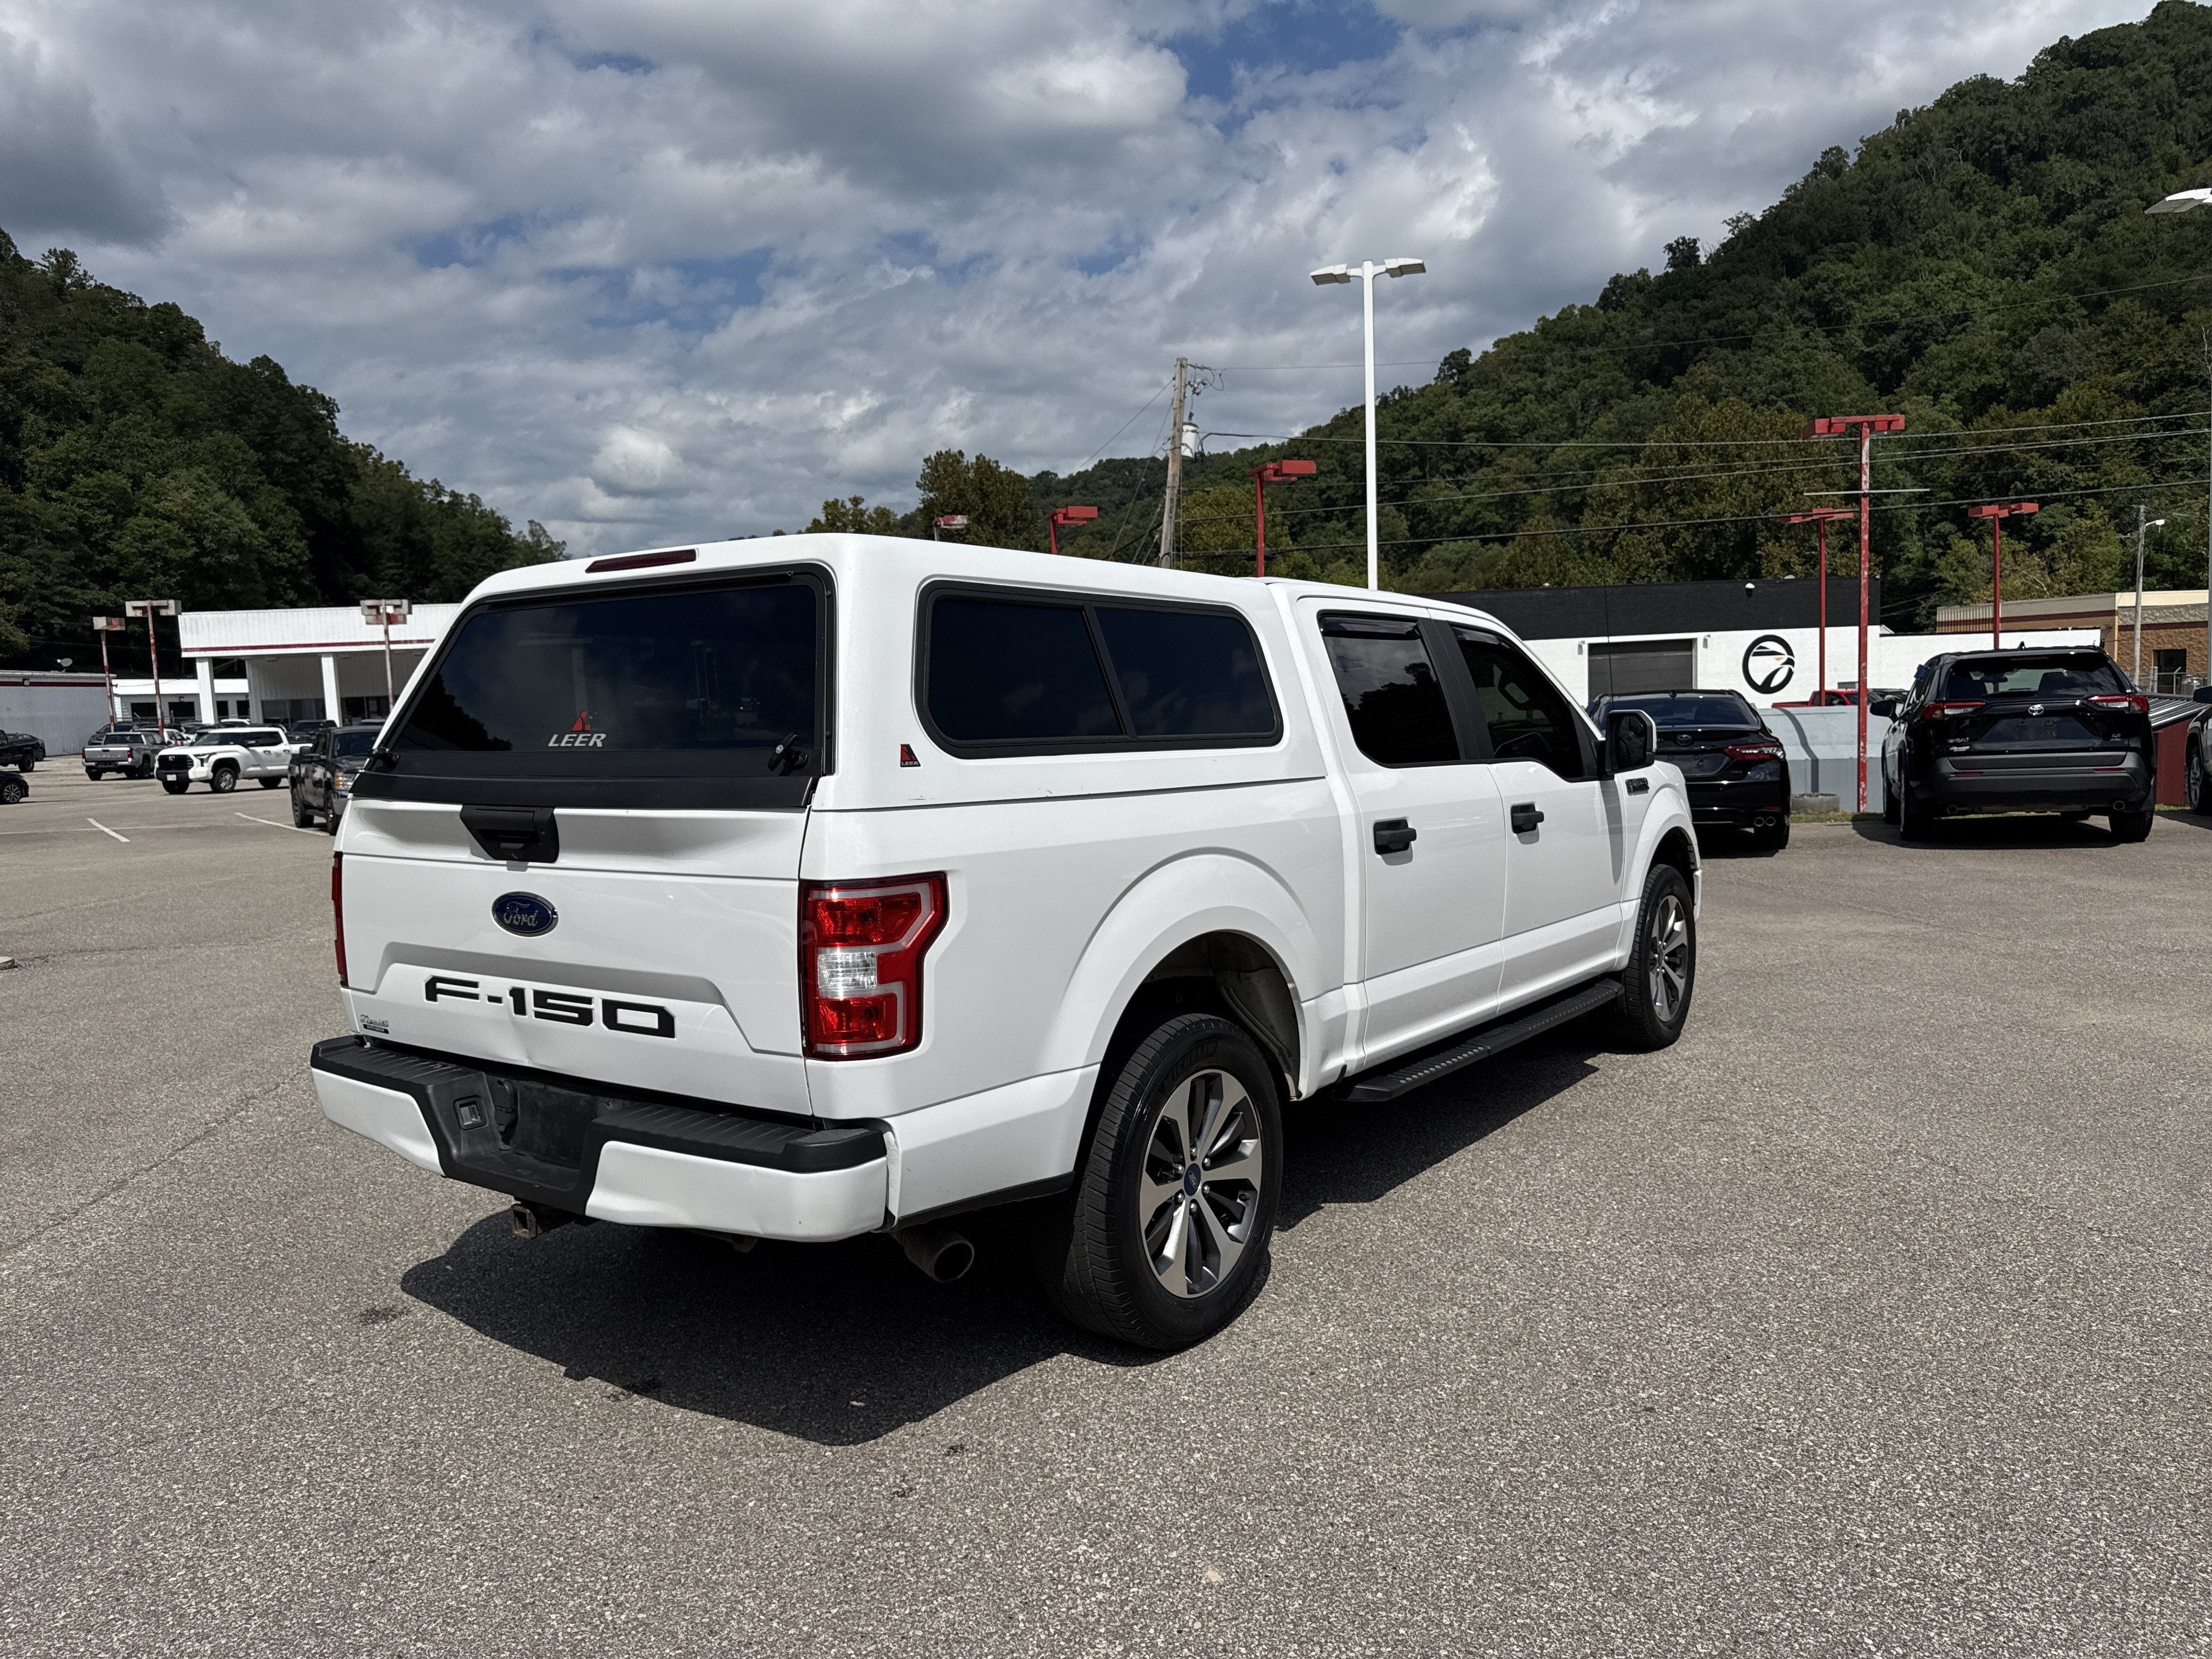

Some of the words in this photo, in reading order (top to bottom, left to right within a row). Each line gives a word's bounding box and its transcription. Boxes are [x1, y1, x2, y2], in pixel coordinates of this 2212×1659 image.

[548, 733, 606, 747] LEER
[503, 901, 539, 927] Ford
[425, 975, 676, 1039] F-150
